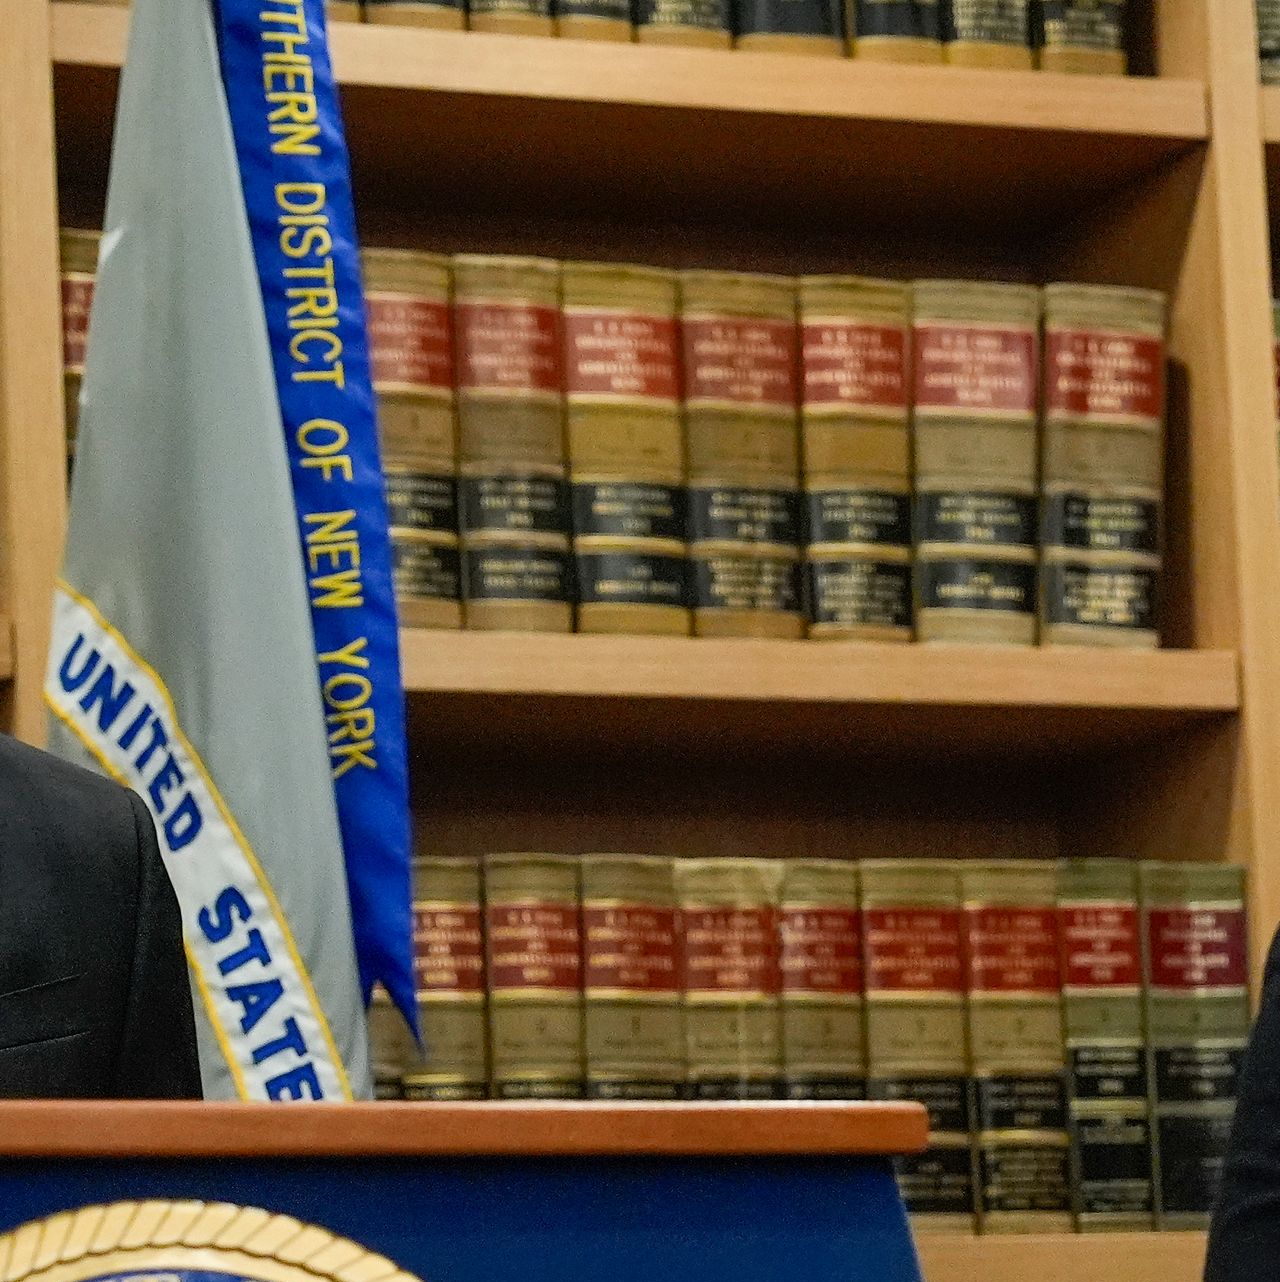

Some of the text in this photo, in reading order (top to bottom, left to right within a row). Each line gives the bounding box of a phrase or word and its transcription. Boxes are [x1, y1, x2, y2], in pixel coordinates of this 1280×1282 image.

[274, 181, 346, 392] DISTRICT
[296, 417, 354, 482] OF
[303, 508, 365, 609] NEW
[318, 635, 378, 780] YORK
[59, 632, 324, 1102] UNITED STATE
